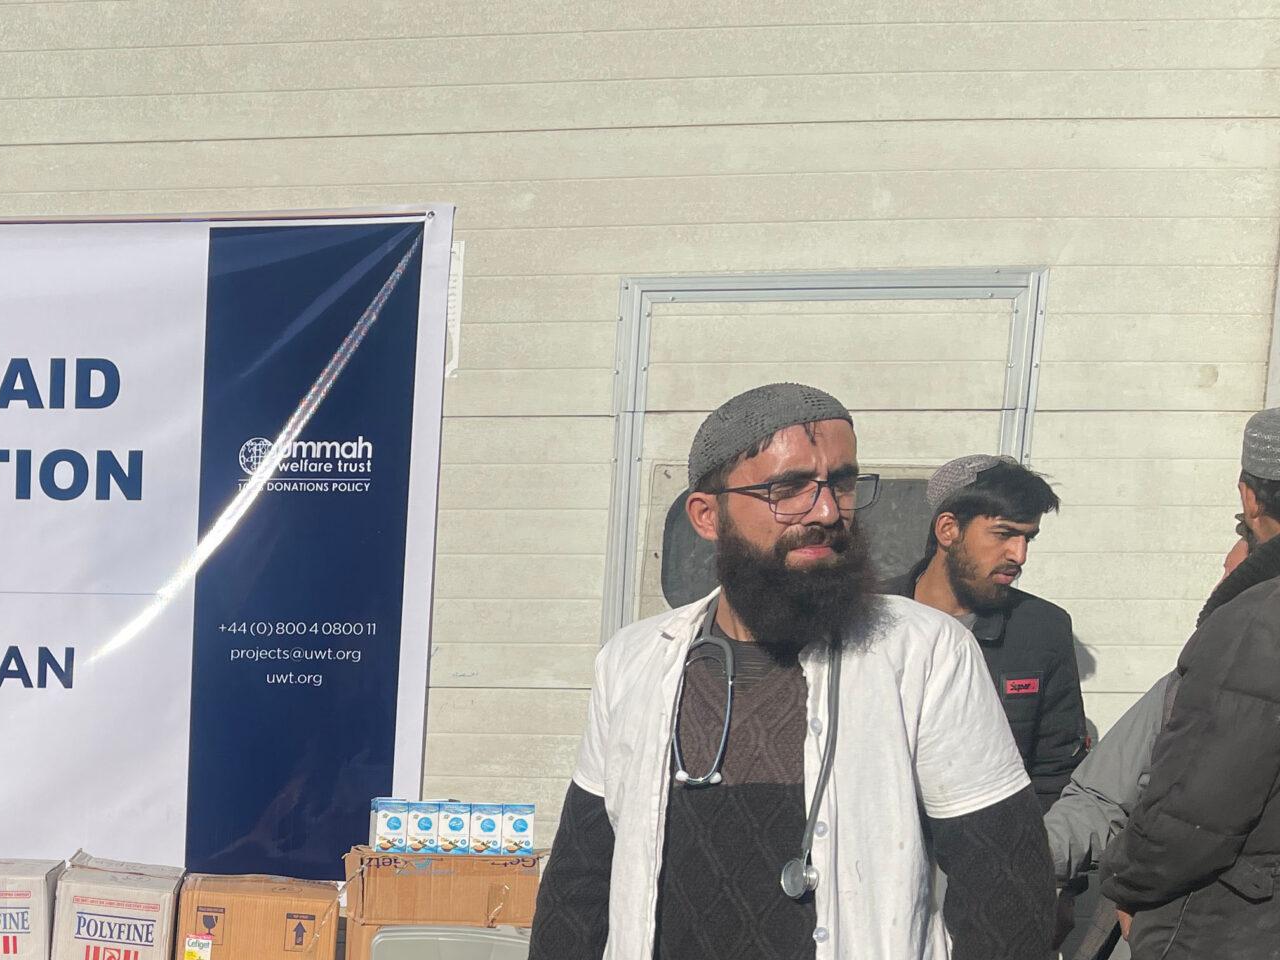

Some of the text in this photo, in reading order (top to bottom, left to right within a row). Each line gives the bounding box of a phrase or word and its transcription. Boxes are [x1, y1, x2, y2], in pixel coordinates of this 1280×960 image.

[278, 460, 372, 473] welfare trust
[266, 482, 329, 492] DONATIONS
[332, 482, 370, 492] POLICY
[218, 622, 247, 635] +44
[230, 647, 362, 662] projects@uwt.org
[266, 672, 322, 686] uwt.org
[75, 914, 155, 943] POLYFINE
